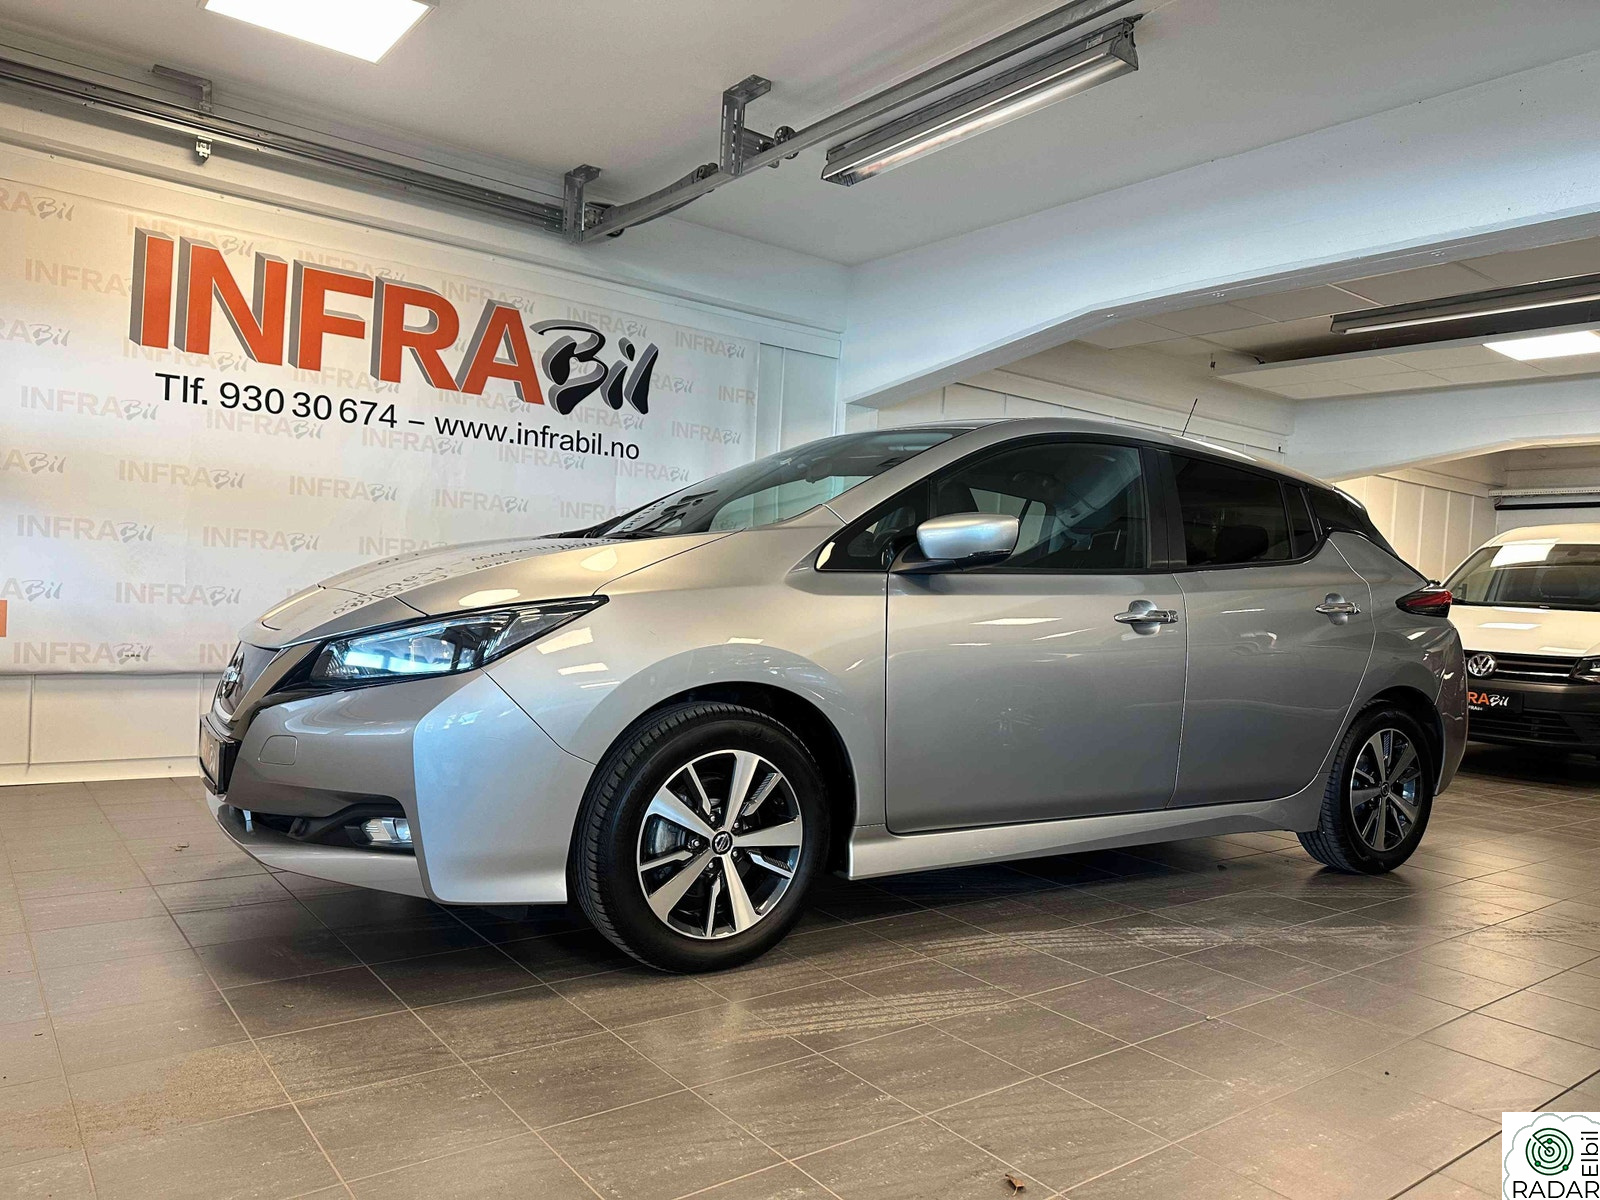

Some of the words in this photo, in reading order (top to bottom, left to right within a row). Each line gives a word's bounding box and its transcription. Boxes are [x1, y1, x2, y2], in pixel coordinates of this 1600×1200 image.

[155, 372, 208, 405] Tlf.
[219, 382, 285, 415] 930
[291, 391, 332, 421] 30
[338, 398, 398, 429] 674
[434, 416, 640, 459] www.infrabil.no
